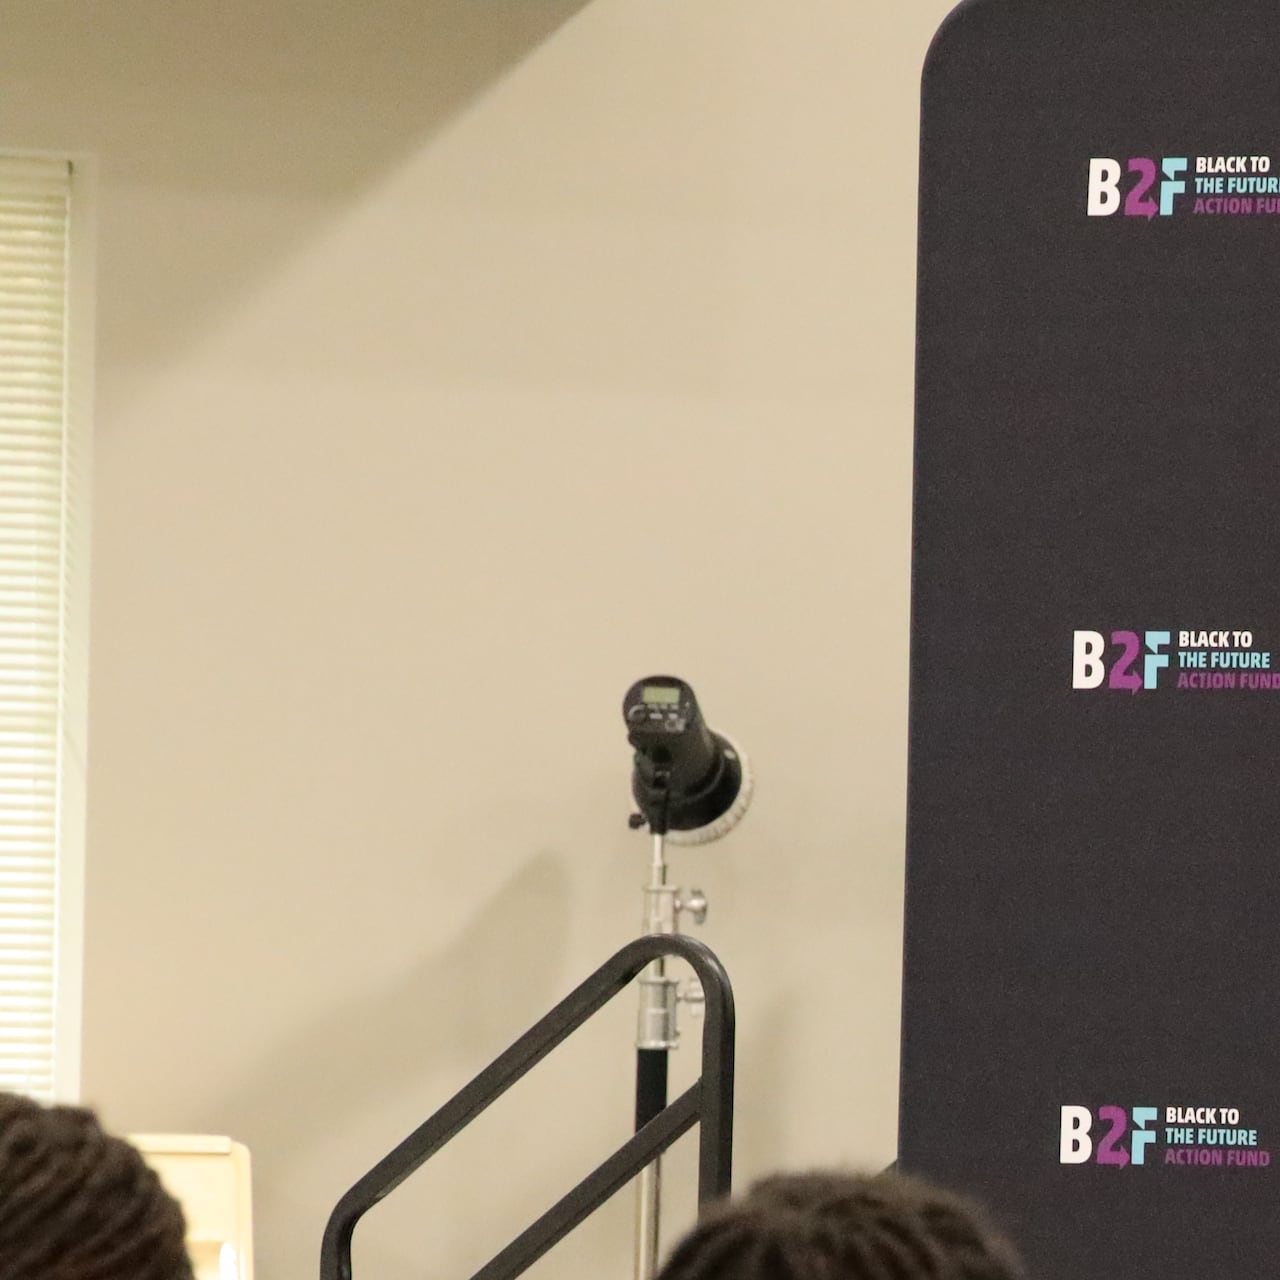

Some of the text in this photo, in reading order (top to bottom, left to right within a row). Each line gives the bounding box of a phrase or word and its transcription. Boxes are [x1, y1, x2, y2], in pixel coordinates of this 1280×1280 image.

[1194, 155, 1272, 172] BLACK TO
[1088, 156, 1188, 219] B2F
[1194, 177, 1225, 192] THE
[1193, 198, 1253, 213] ACTION
[1177, 630, 1254, 646] BLACK TO
[1073, 630, 1171, 693] B2F
[1177, 652, 1271, 667] THE FUTURE
[1177, 672, 1236, 688] ACTION
[1164, 1107, 1241, 1125] BLACK TO
[1060, 1105, 1158, 1169] B2F
[1164, 1128, 1259, 1145] THE FUTURE
[1165, 1148, 1270, 1165] ACTION FUND
